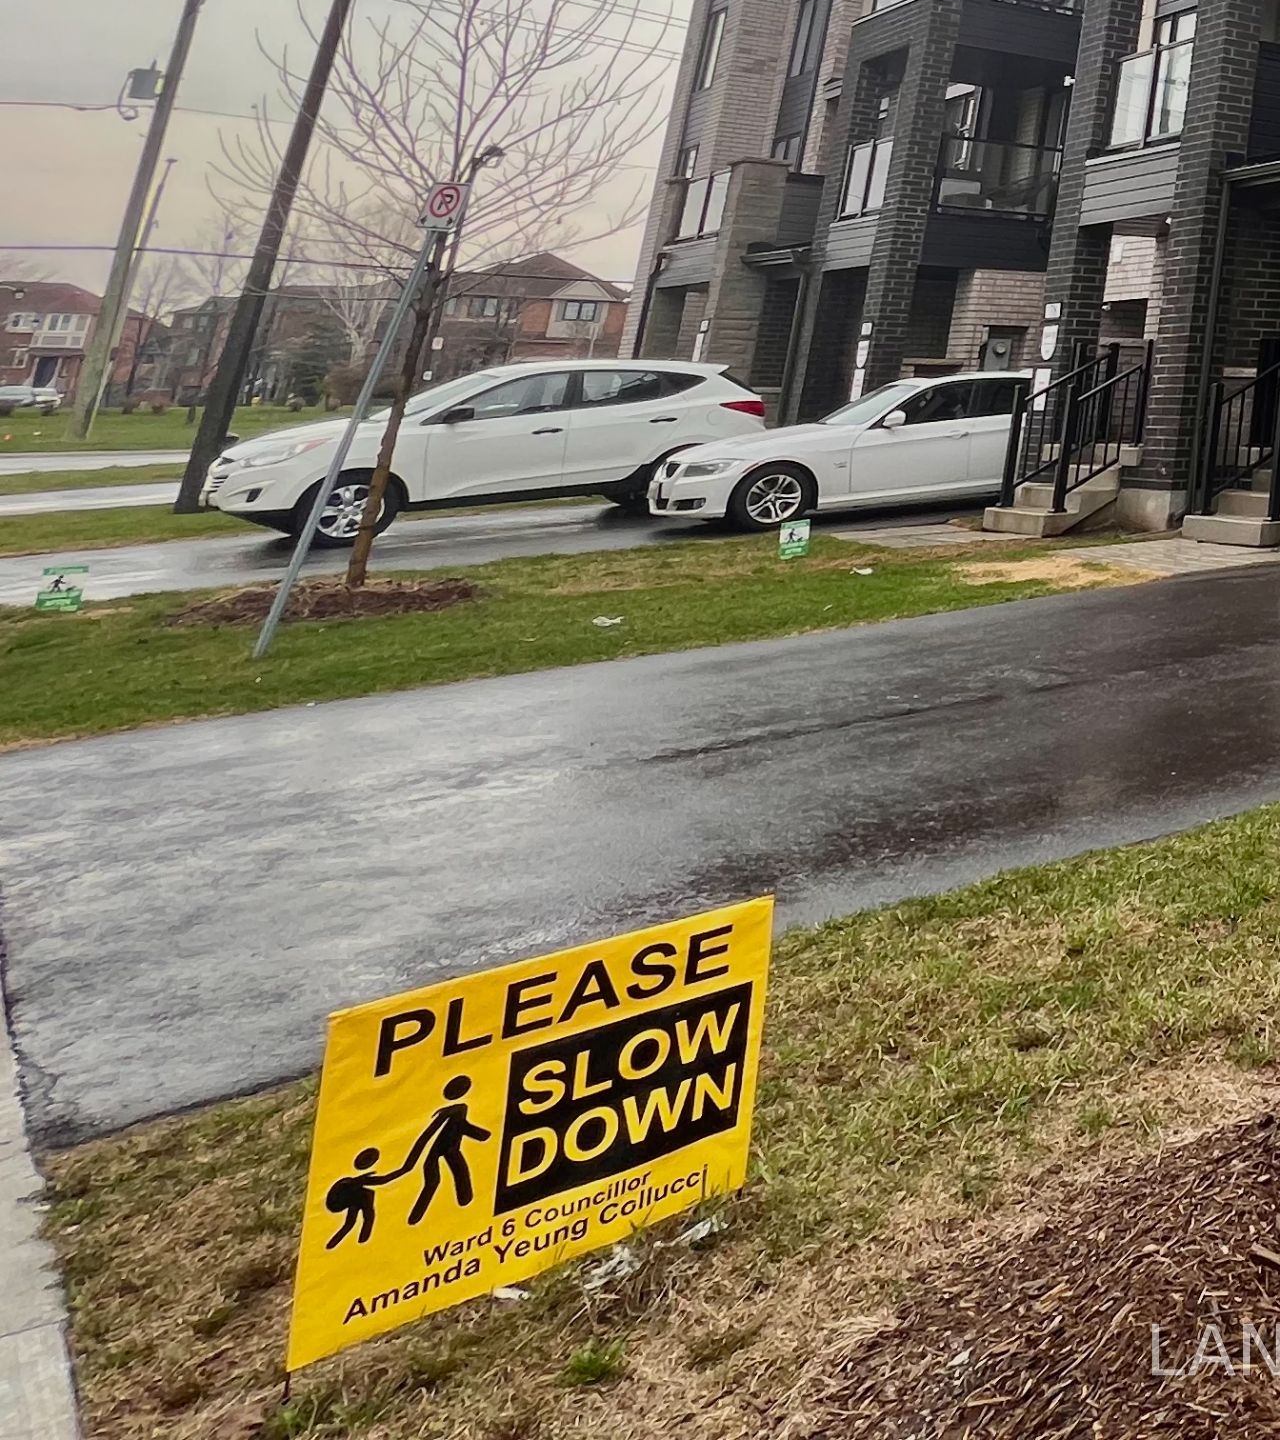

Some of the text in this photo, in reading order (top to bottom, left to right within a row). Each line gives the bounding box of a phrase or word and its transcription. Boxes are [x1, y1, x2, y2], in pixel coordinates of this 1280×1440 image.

[374, 924, 733, 1078] PLEASE
[518, 1001, 741, 1116] SLOW
[505, 1063, 737, 1187] DOWN
[343, 1164, 709, 1324] Amanda Yeung Collucci
[424, 1171, 652, 1266] Ward 6 Councillor
